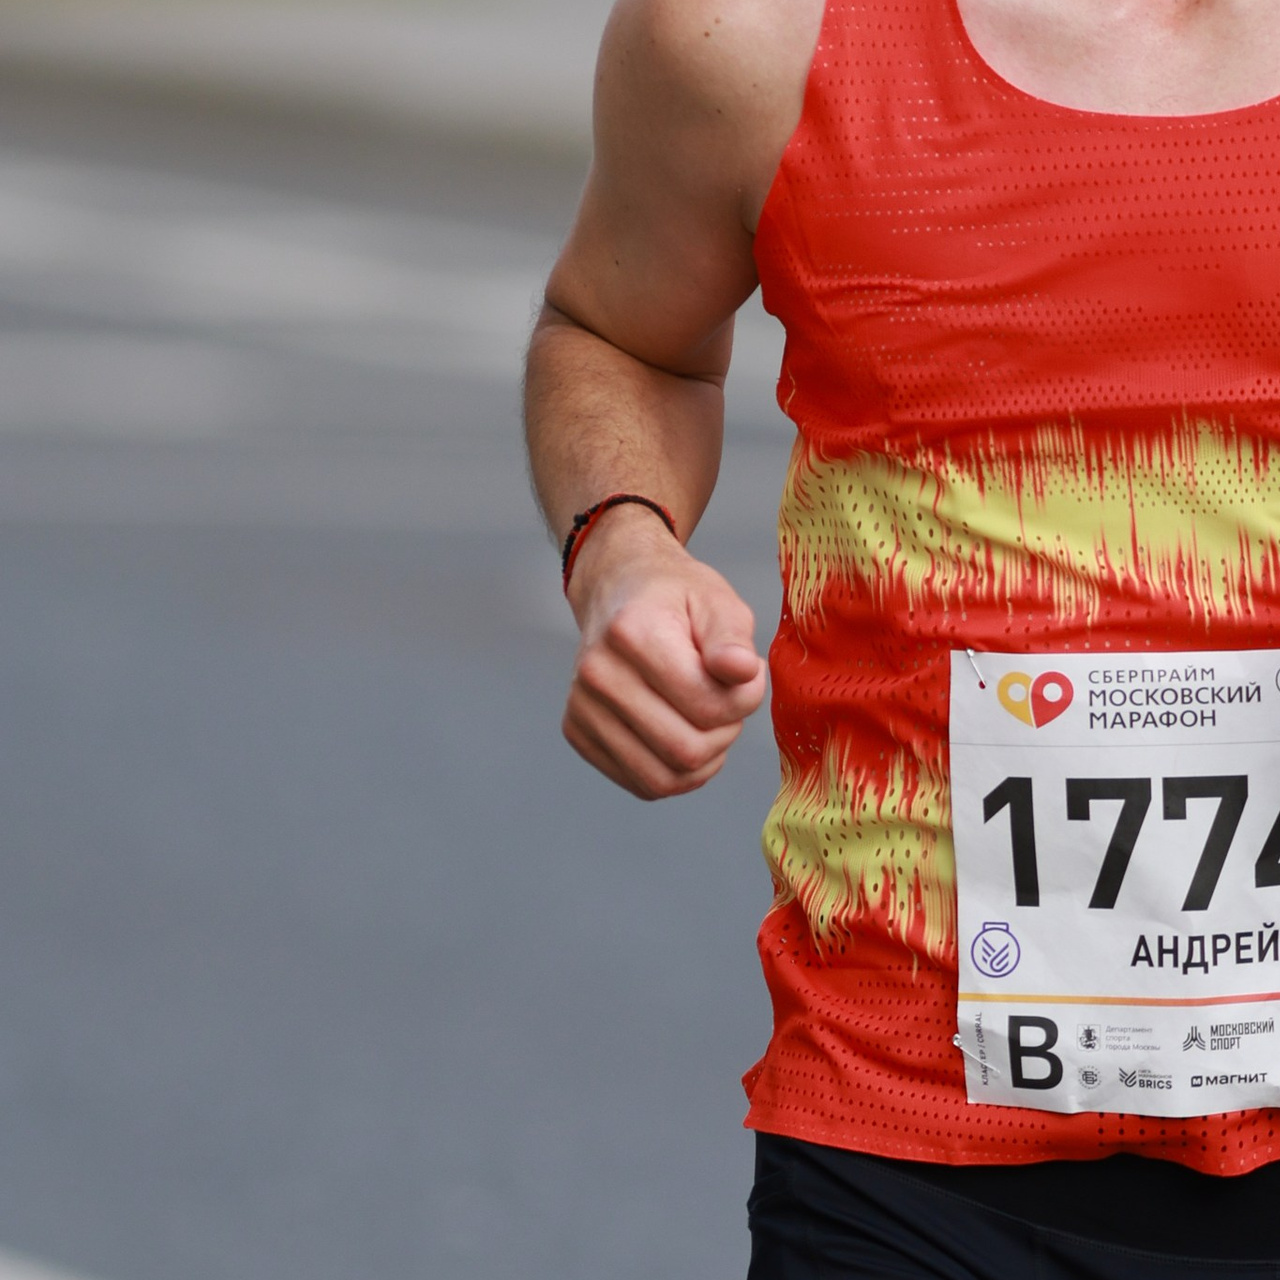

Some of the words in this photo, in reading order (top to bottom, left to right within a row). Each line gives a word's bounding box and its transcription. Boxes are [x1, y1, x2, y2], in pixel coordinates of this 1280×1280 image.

[1088, 665, 1215, 684] СБЕРПРАЙМ
[1088, 682, 1262, 707] МОСКОВСКИЙ
[1088, 709, 1216, 730] МАРАФОН
[1131, 922, 1280, 975] АНДРЕЙ
[975, 1012, 985, 1043] CORRAL
[1209, 1017, 1275, 1037] МОСКОВСКИЙ
[1209, 1036, 1242, 1051] СПОРТ
[979, 1049, 989, 1086] КЛАСЕР
[1138, 1079, 1173, 1090] BRICS
